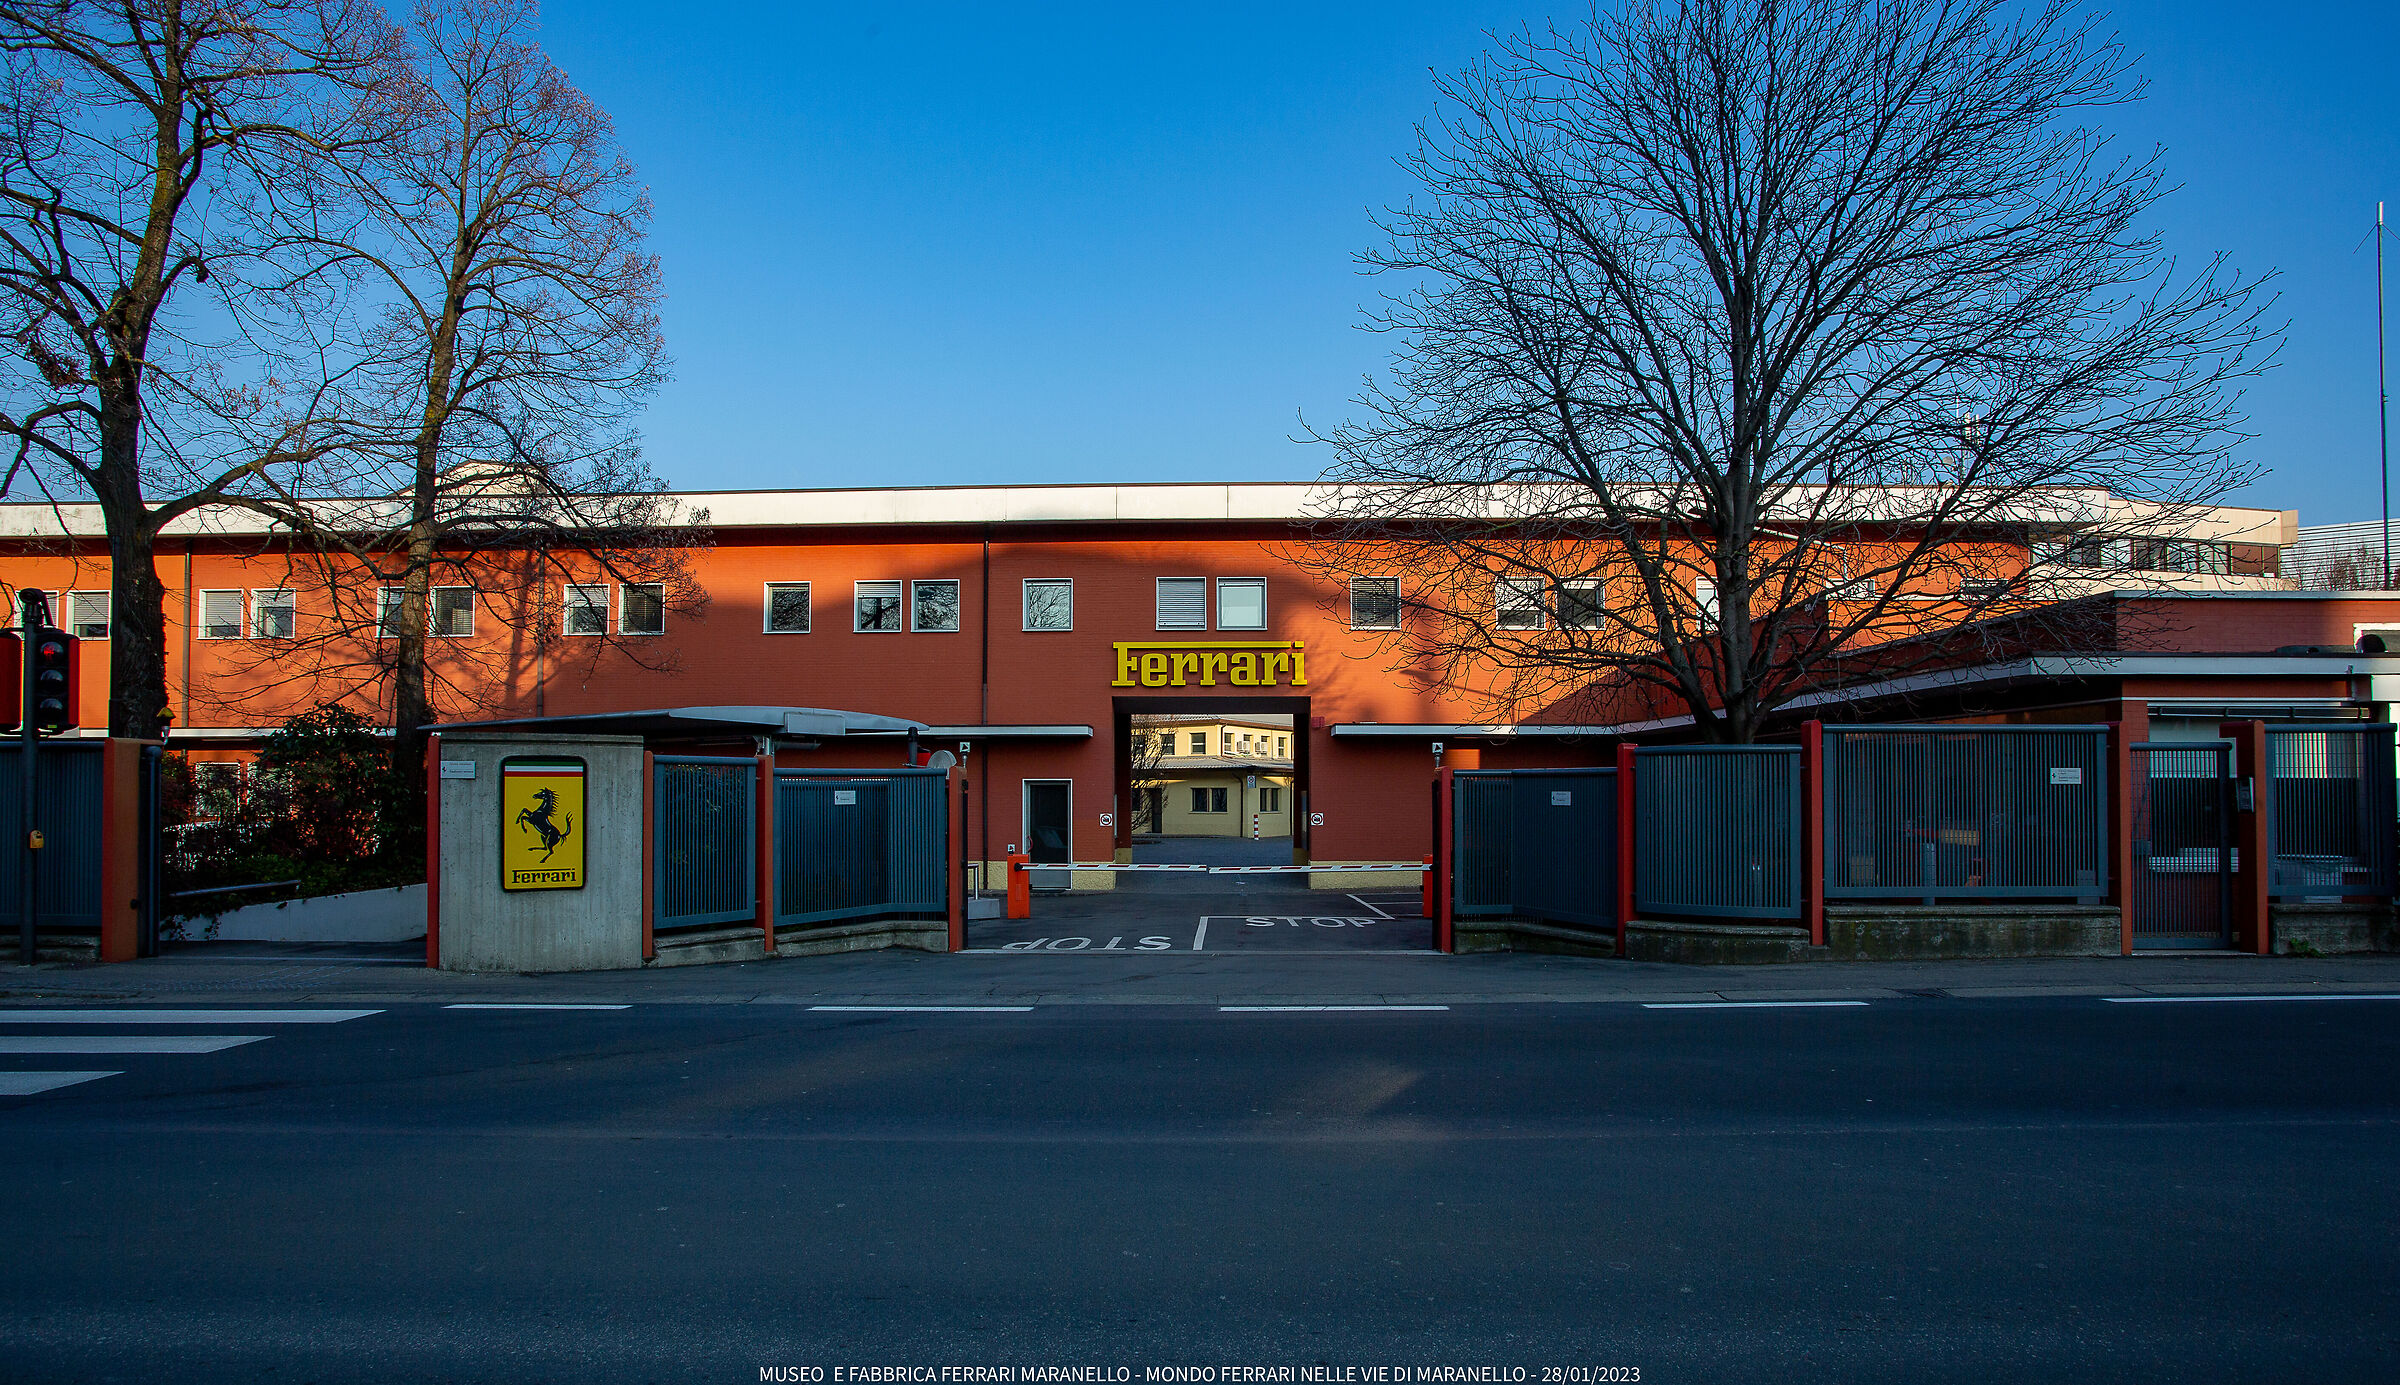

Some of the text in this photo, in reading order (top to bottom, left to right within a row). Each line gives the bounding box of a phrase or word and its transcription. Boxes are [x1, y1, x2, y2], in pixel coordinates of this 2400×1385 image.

[1111, 641, 1308, 687] Ferrari
[512, 868, 576, 883] Ferrari
[1244, 917, 1377, 928] STOP
[1001, 935, 1172, 950] STOP
